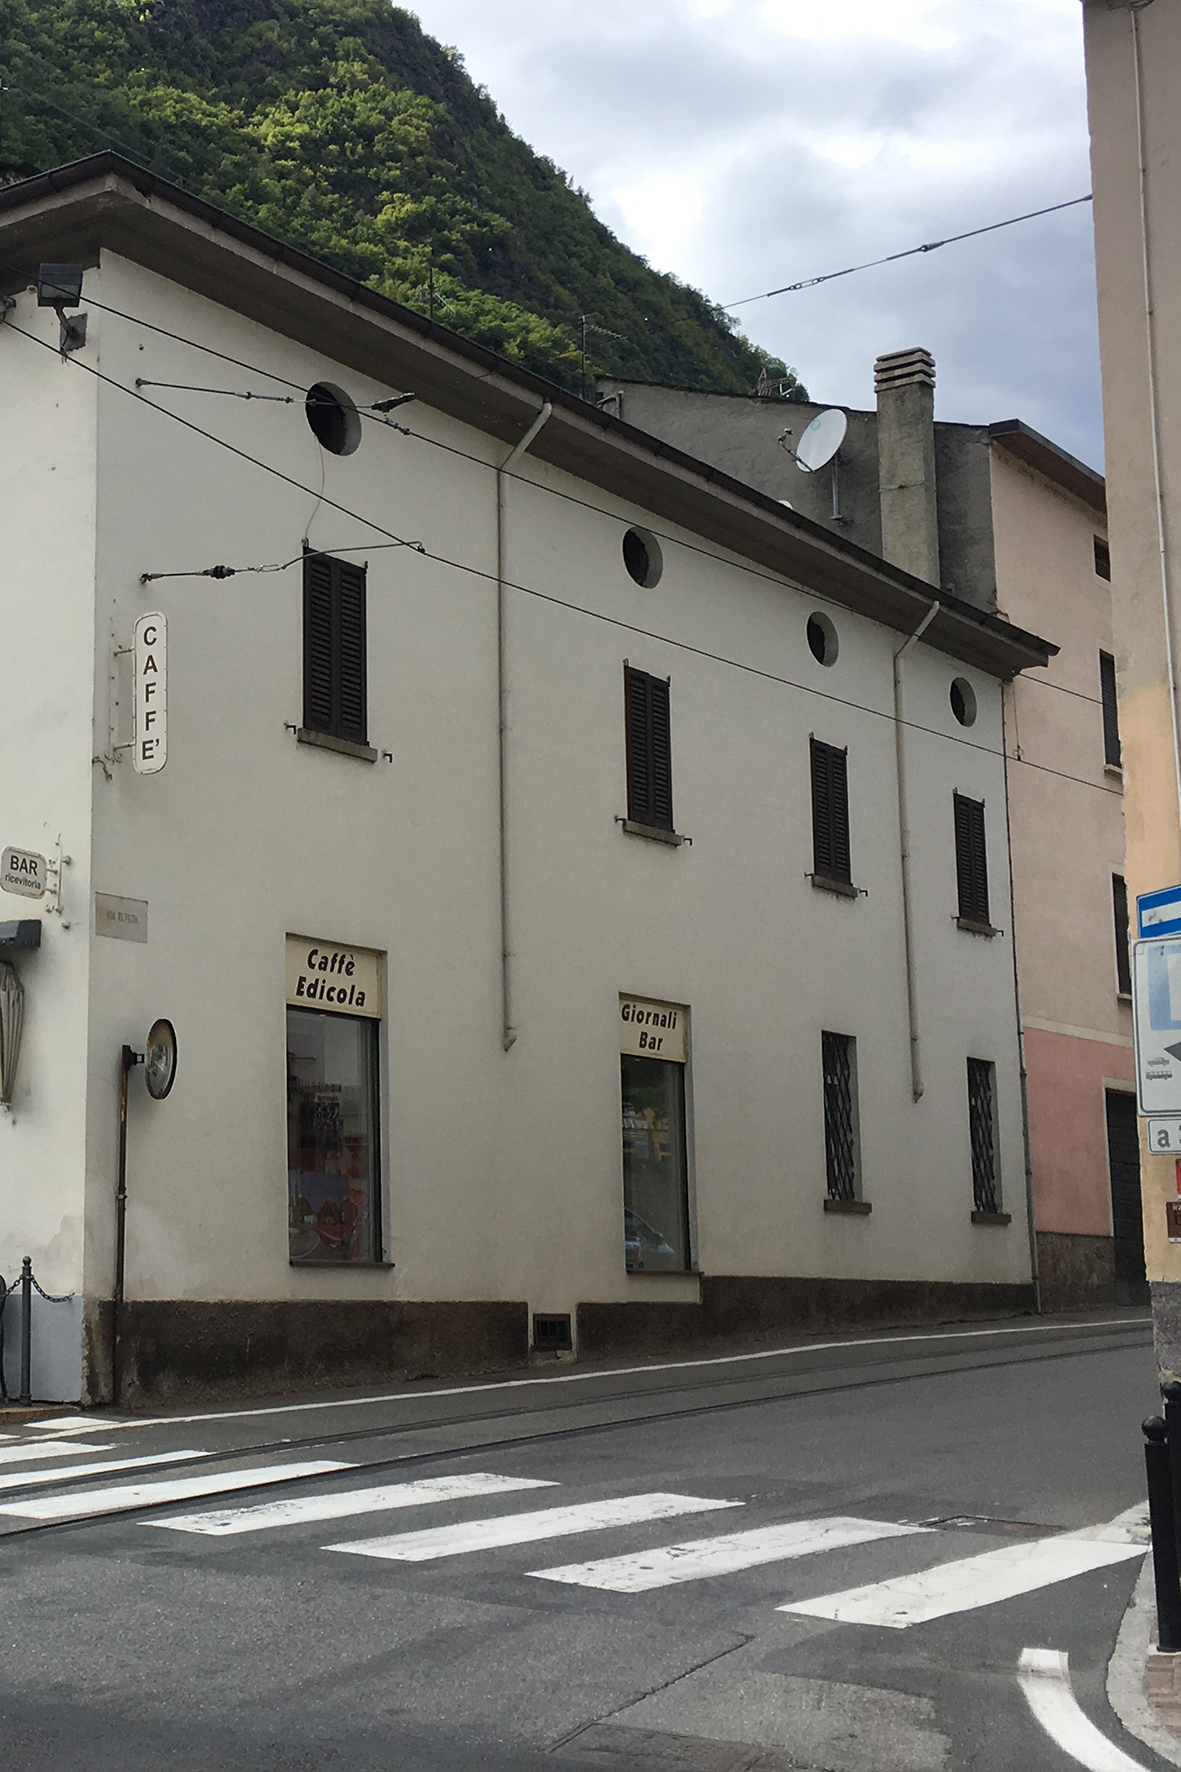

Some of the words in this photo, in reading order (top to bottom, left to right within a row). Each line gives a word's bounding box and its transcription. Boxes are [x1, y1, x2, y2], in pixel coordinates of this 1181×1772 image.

[10, 854, 38, 877] BAR
[5, 872, 41, 890] ricevitoria
[306, 948, 356, 977] Caffè
[295, 976, 367, 1008] Edicola
[621, 1003, 677, 1030] Giornali
[638, 1031, 663, 1051] Bar
